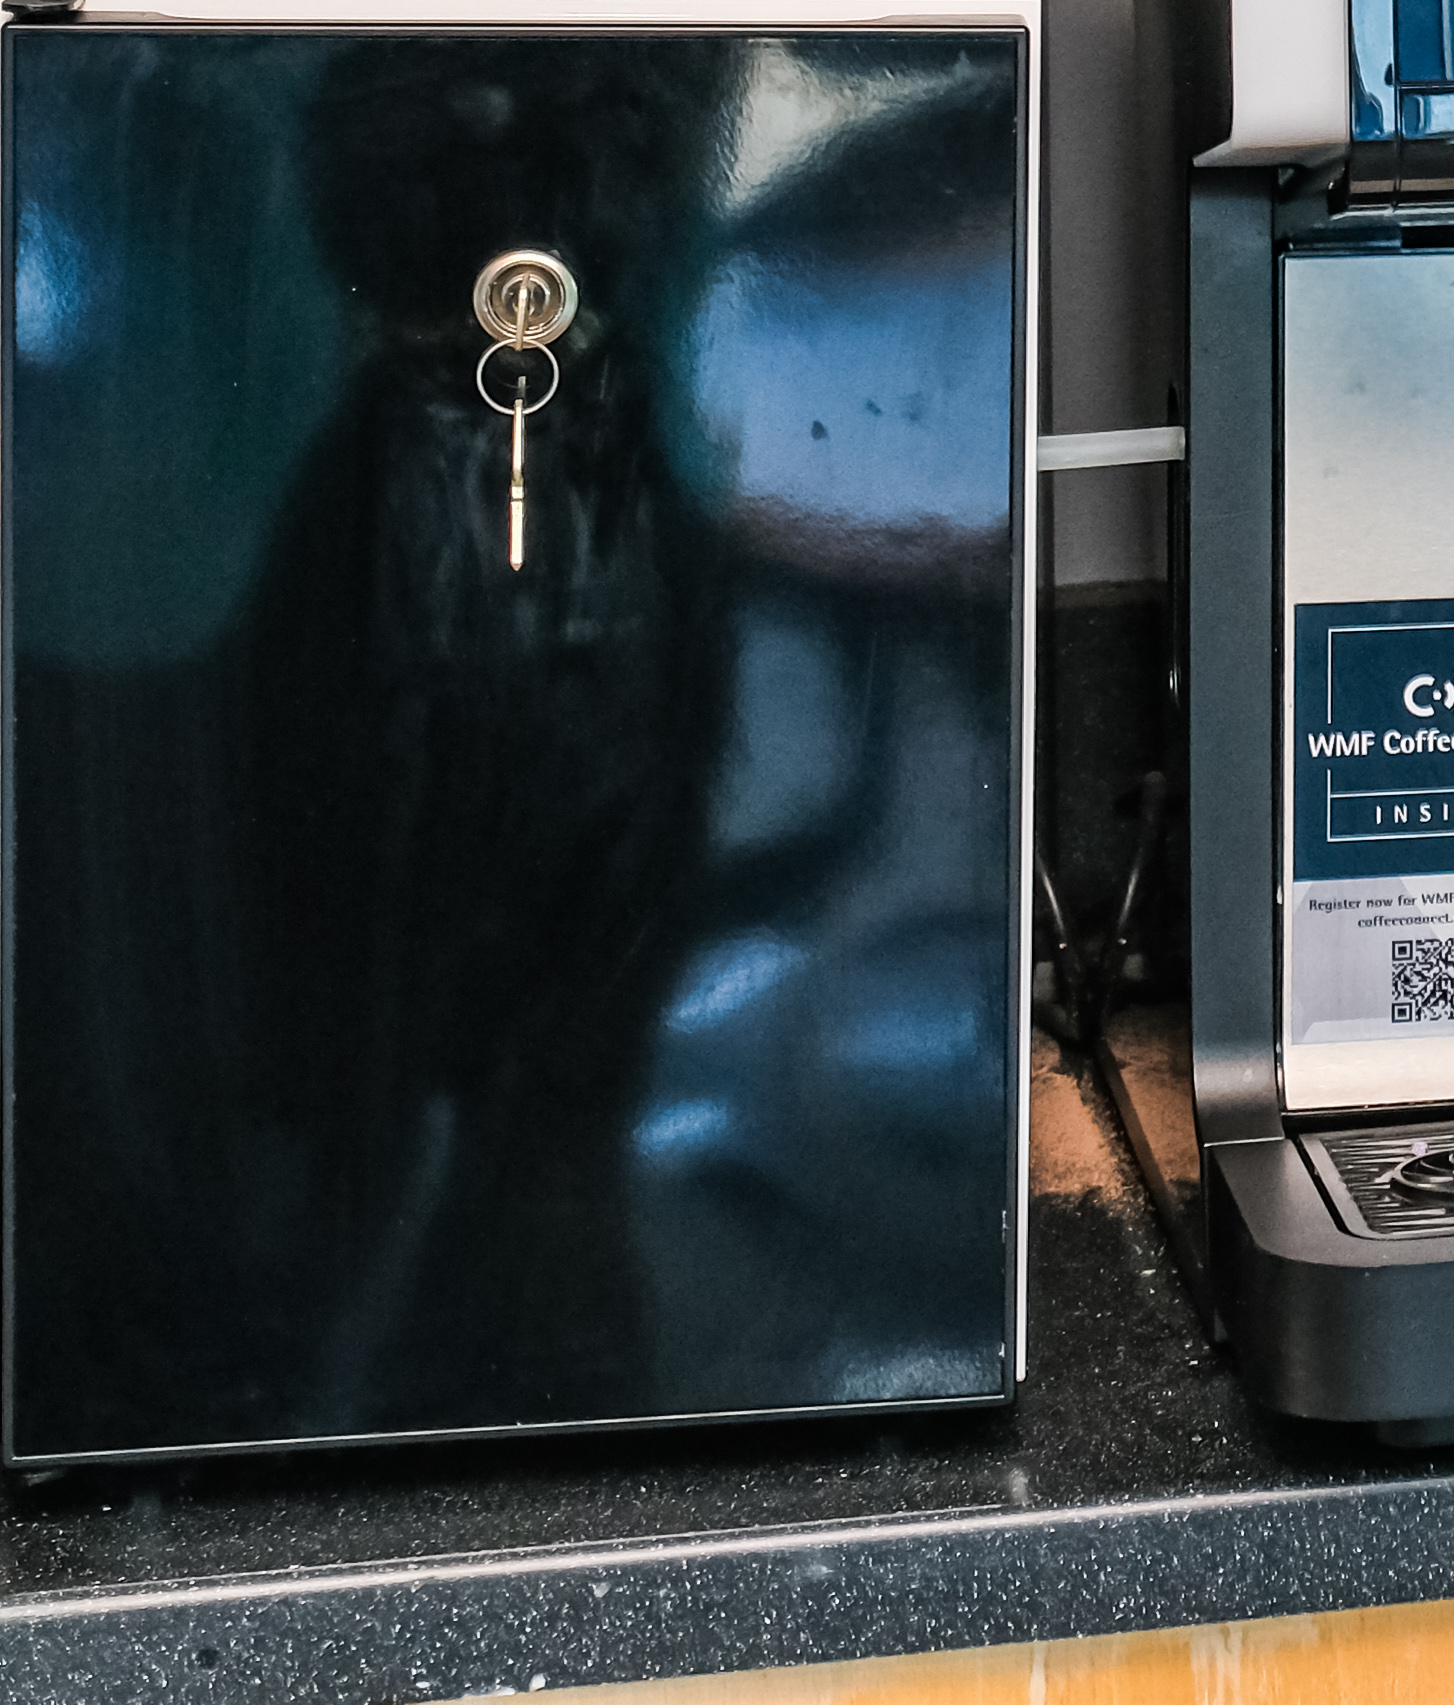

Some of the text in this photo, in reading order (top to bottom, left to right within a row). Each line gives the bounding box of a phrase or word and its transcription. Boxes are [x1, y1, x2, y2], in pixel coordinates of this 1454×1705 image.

[1307, 730, 1377, 758] WMF
[1309, 898, 1361, 914] Register
[1366, 898, 1393, 908] now
[1397, 894, 1418, 907] for
